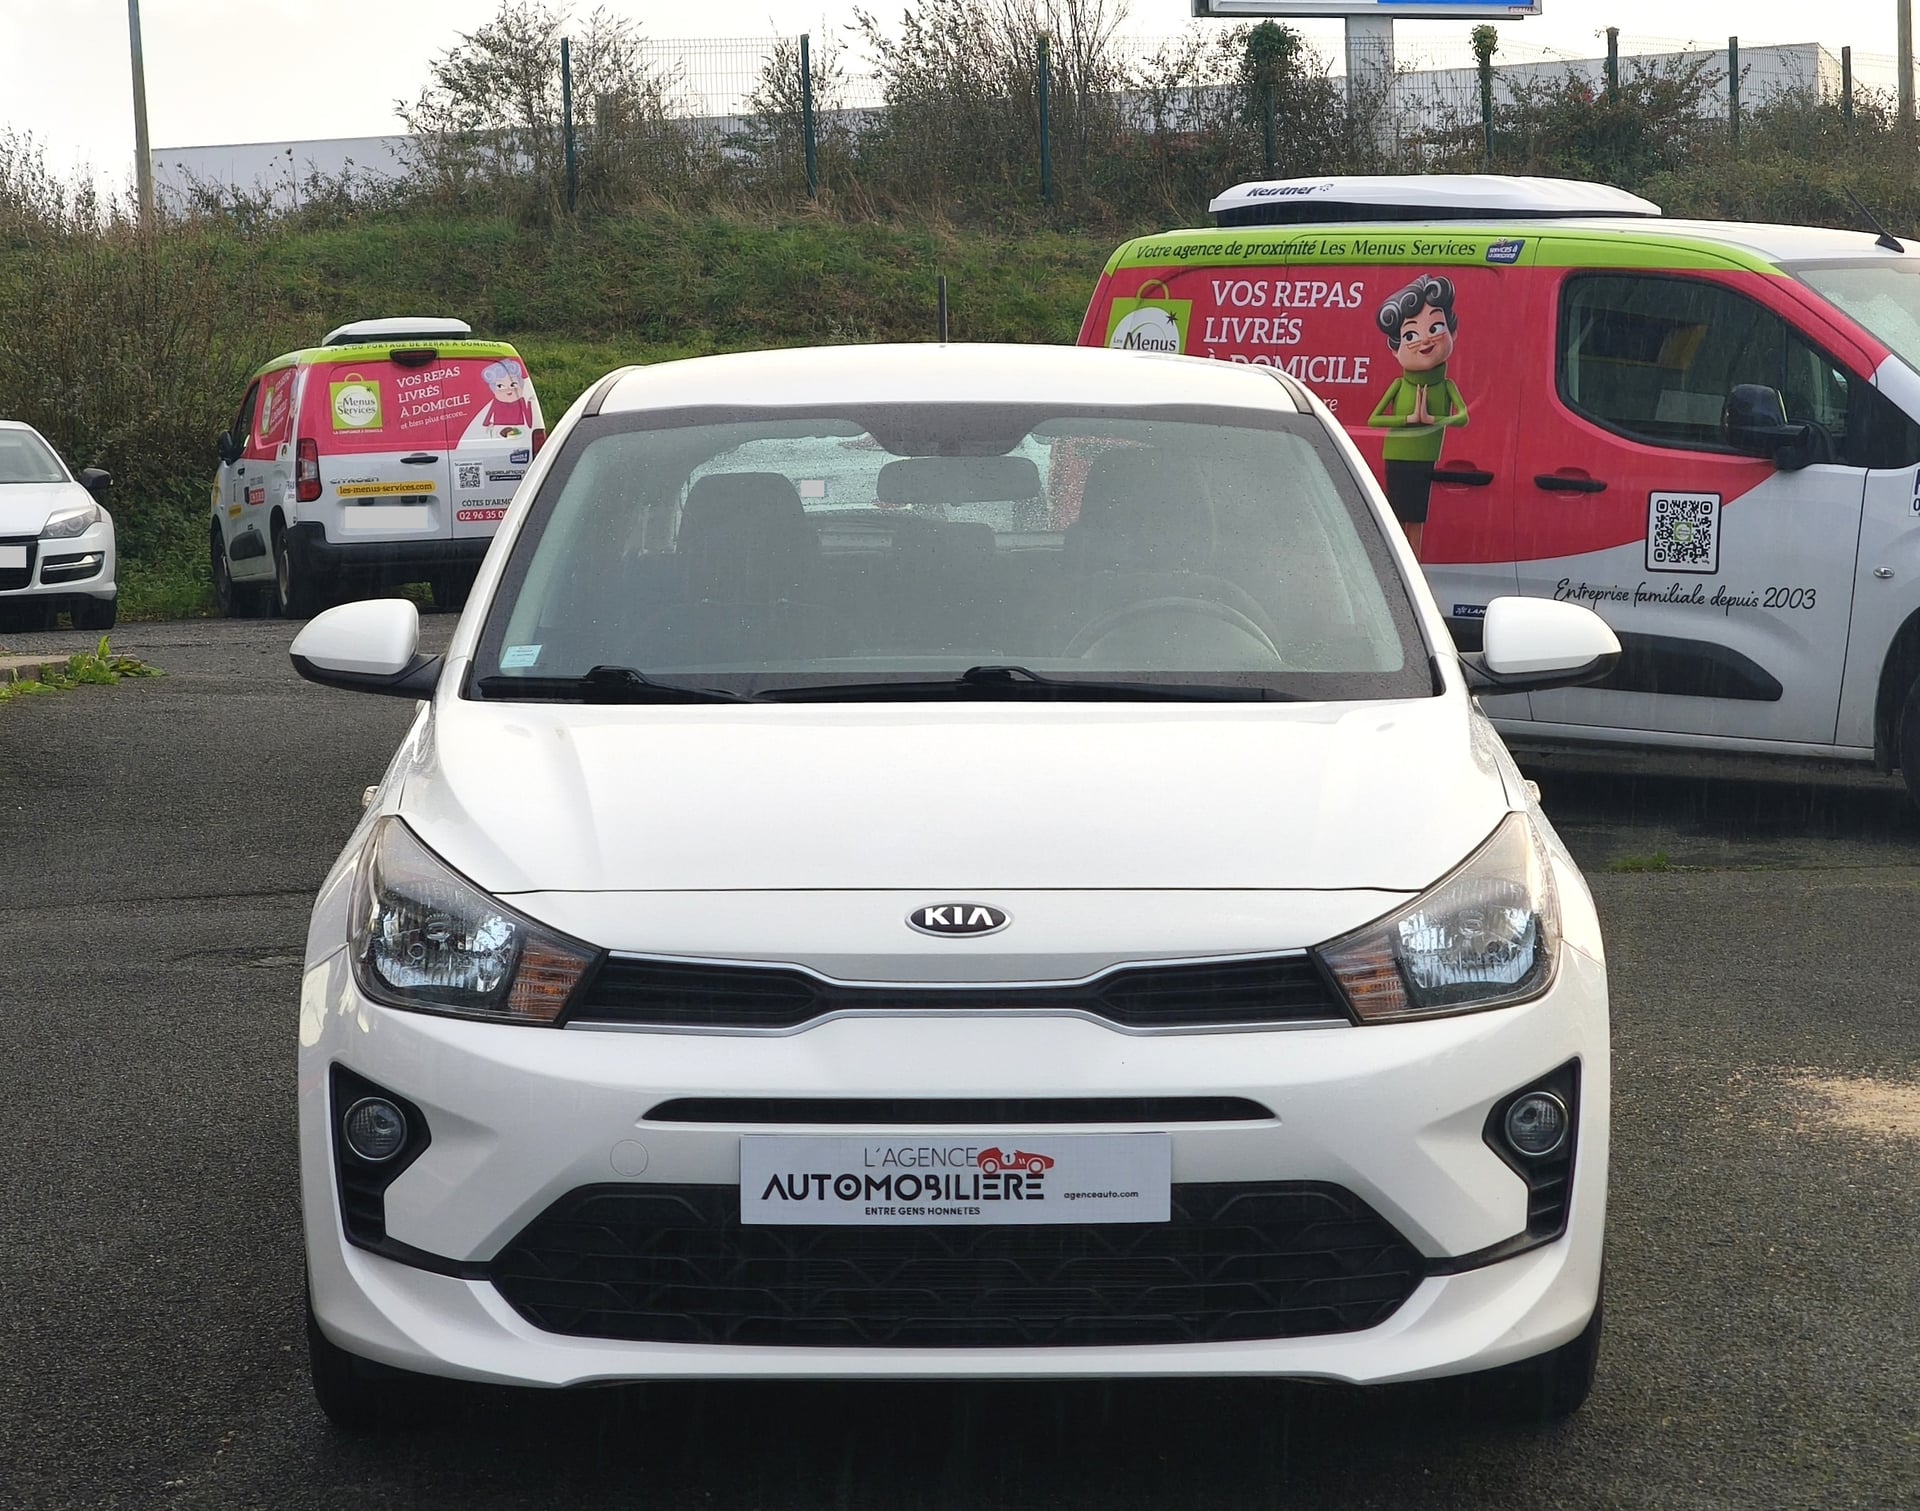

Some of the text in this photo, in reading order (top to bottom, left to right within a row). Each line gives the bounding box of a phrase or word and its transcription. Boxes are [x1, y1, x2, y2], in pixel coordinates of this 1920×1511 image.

[1137, 240, 1476, 259] Votre agence de proximité Les Menus Services
[1212, 280, 1364, 308] VOS REPAS
[1203, 312, 1302, 344] LIVRÉS
[1123, 331, 1177, 351] Menus
[397, 366, 460, 388] VOS REPAS
[343, 396, 376, 406] Menus
[398, 385, 440, 403] LIVRÉS
[337, 405, 376, 415] Services
[412, 394, 471, 416] DOMICILE
[340, 483, 433, 495] les-menus-services.com
[462, 498, 485, 507] CÔTES
[459, 511, 471, 519] 02
[473, 511, 484, 519] 96
[486, 510, 496, 519] 35
[1554, 578, 1817, 616] Entreprise familiale depuis 2003
[924, 906, 994, 926] KIA
[864, 1147, 978, 1167] L'AGENCE
[1063, 1189, 1139, 1201] agenceauto.com
[865, 1206, 896, 1215] ENTRE
[898, 1206, 925, 1215] GENS
